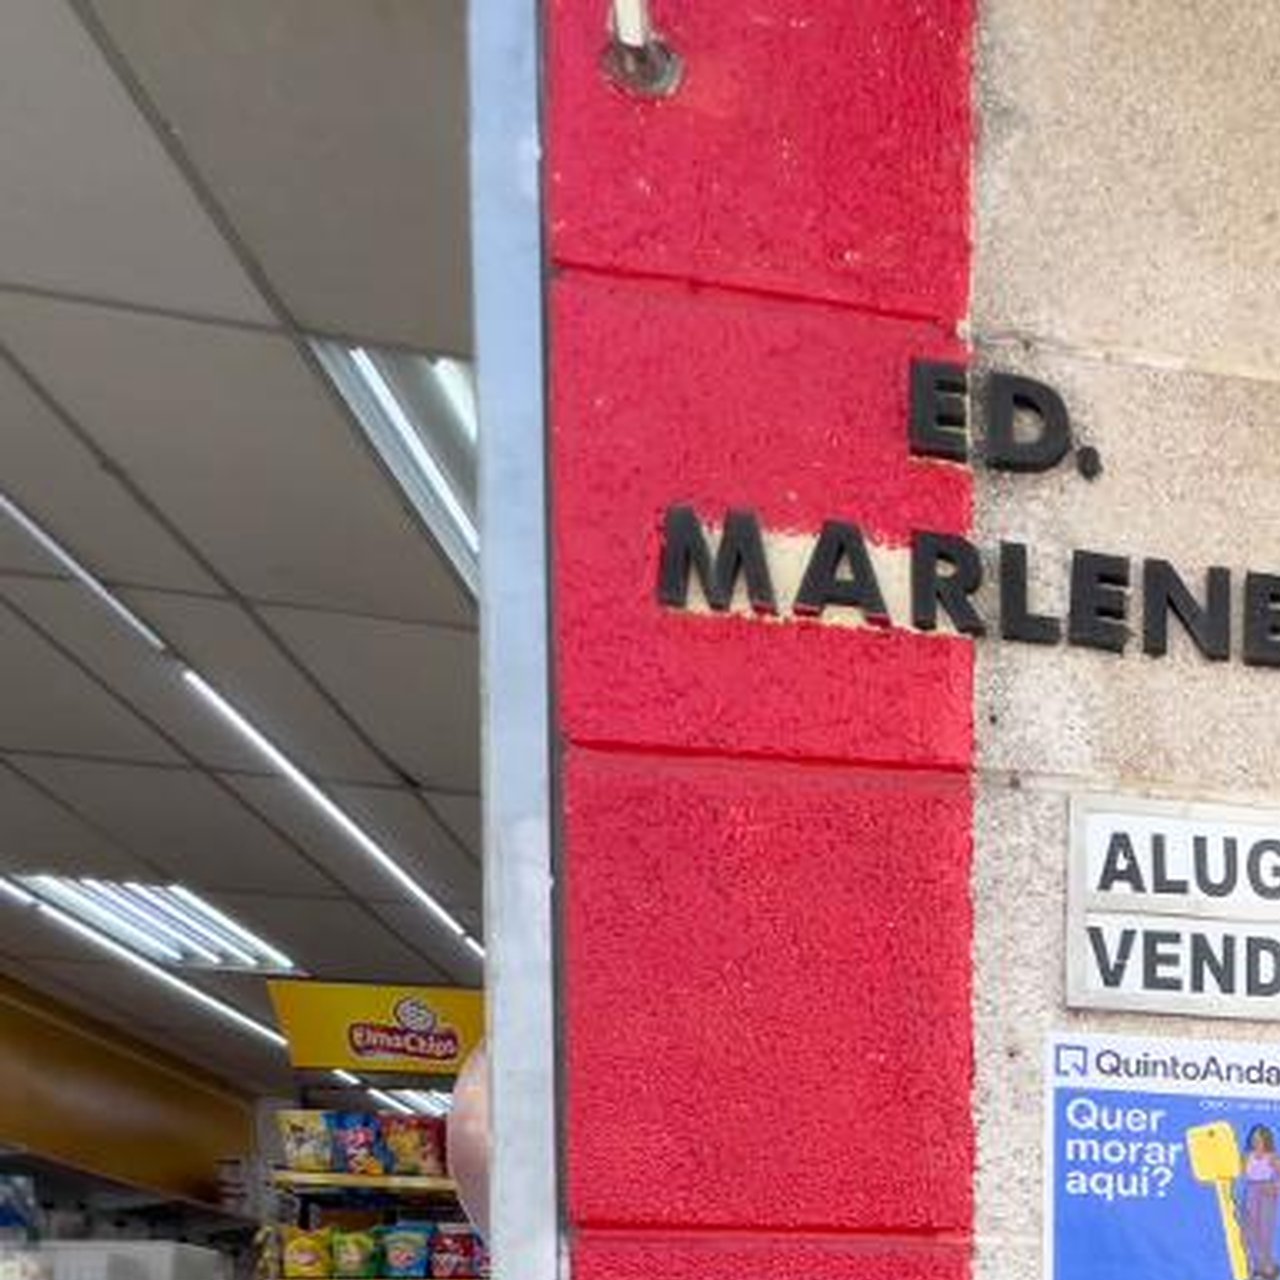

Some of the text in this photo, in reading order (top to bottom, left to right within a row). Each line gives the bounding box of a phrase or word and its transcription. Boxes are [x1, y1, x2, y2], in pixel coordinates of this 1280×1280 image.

[909, 358, 1101, 480] ED.
[1066, 1098, 1166, 1132] Quer
[1066, 1139, 1184, 1166] morar
[1066, 1165, 1173, 1201] aqui?
